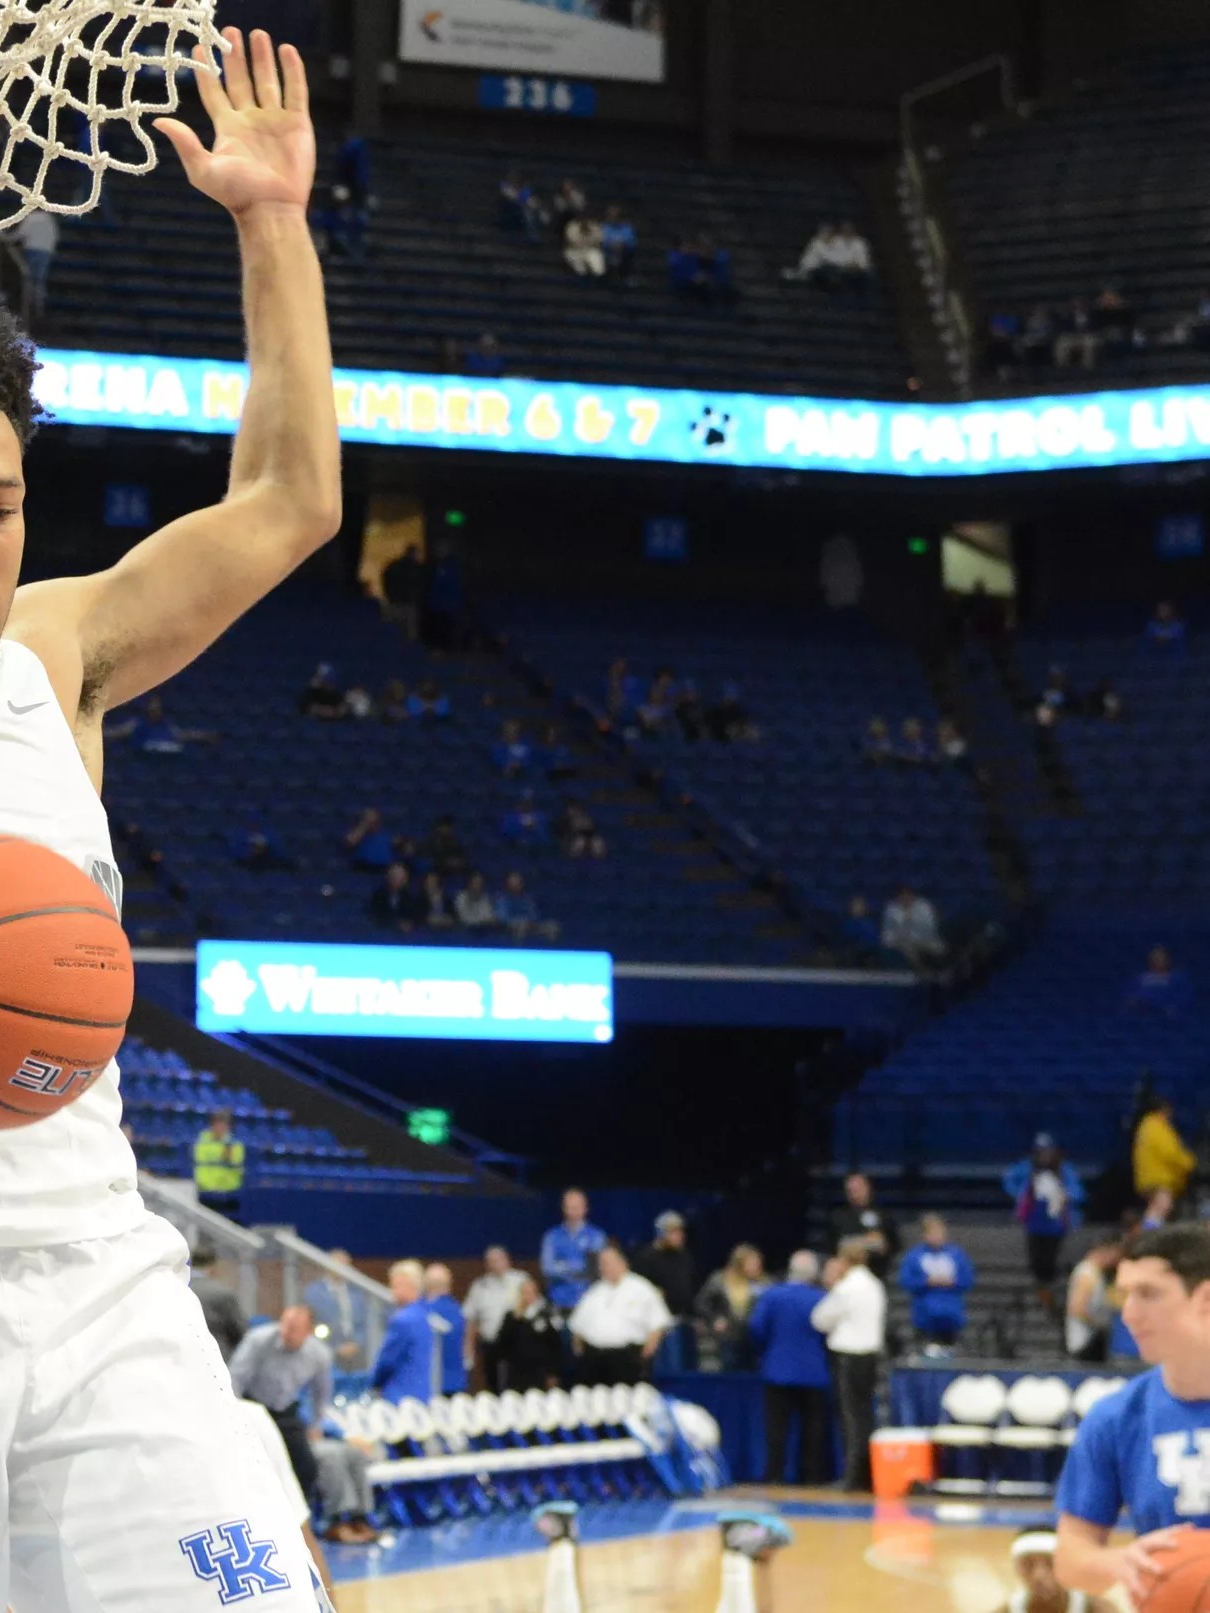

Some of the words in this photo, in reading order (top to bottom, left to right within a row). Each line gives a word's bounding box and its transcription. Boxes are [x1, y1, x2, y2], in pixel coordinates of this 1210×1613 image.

[525, 394, 561, 441] 6
[575, 396, 615, 444] &
[626, 400, 661, 446] 7
[764, 405, 880, 461] PAW
[890, 406, 1116, 464] PATROL
[178, 1518, 291, 1606] UK
